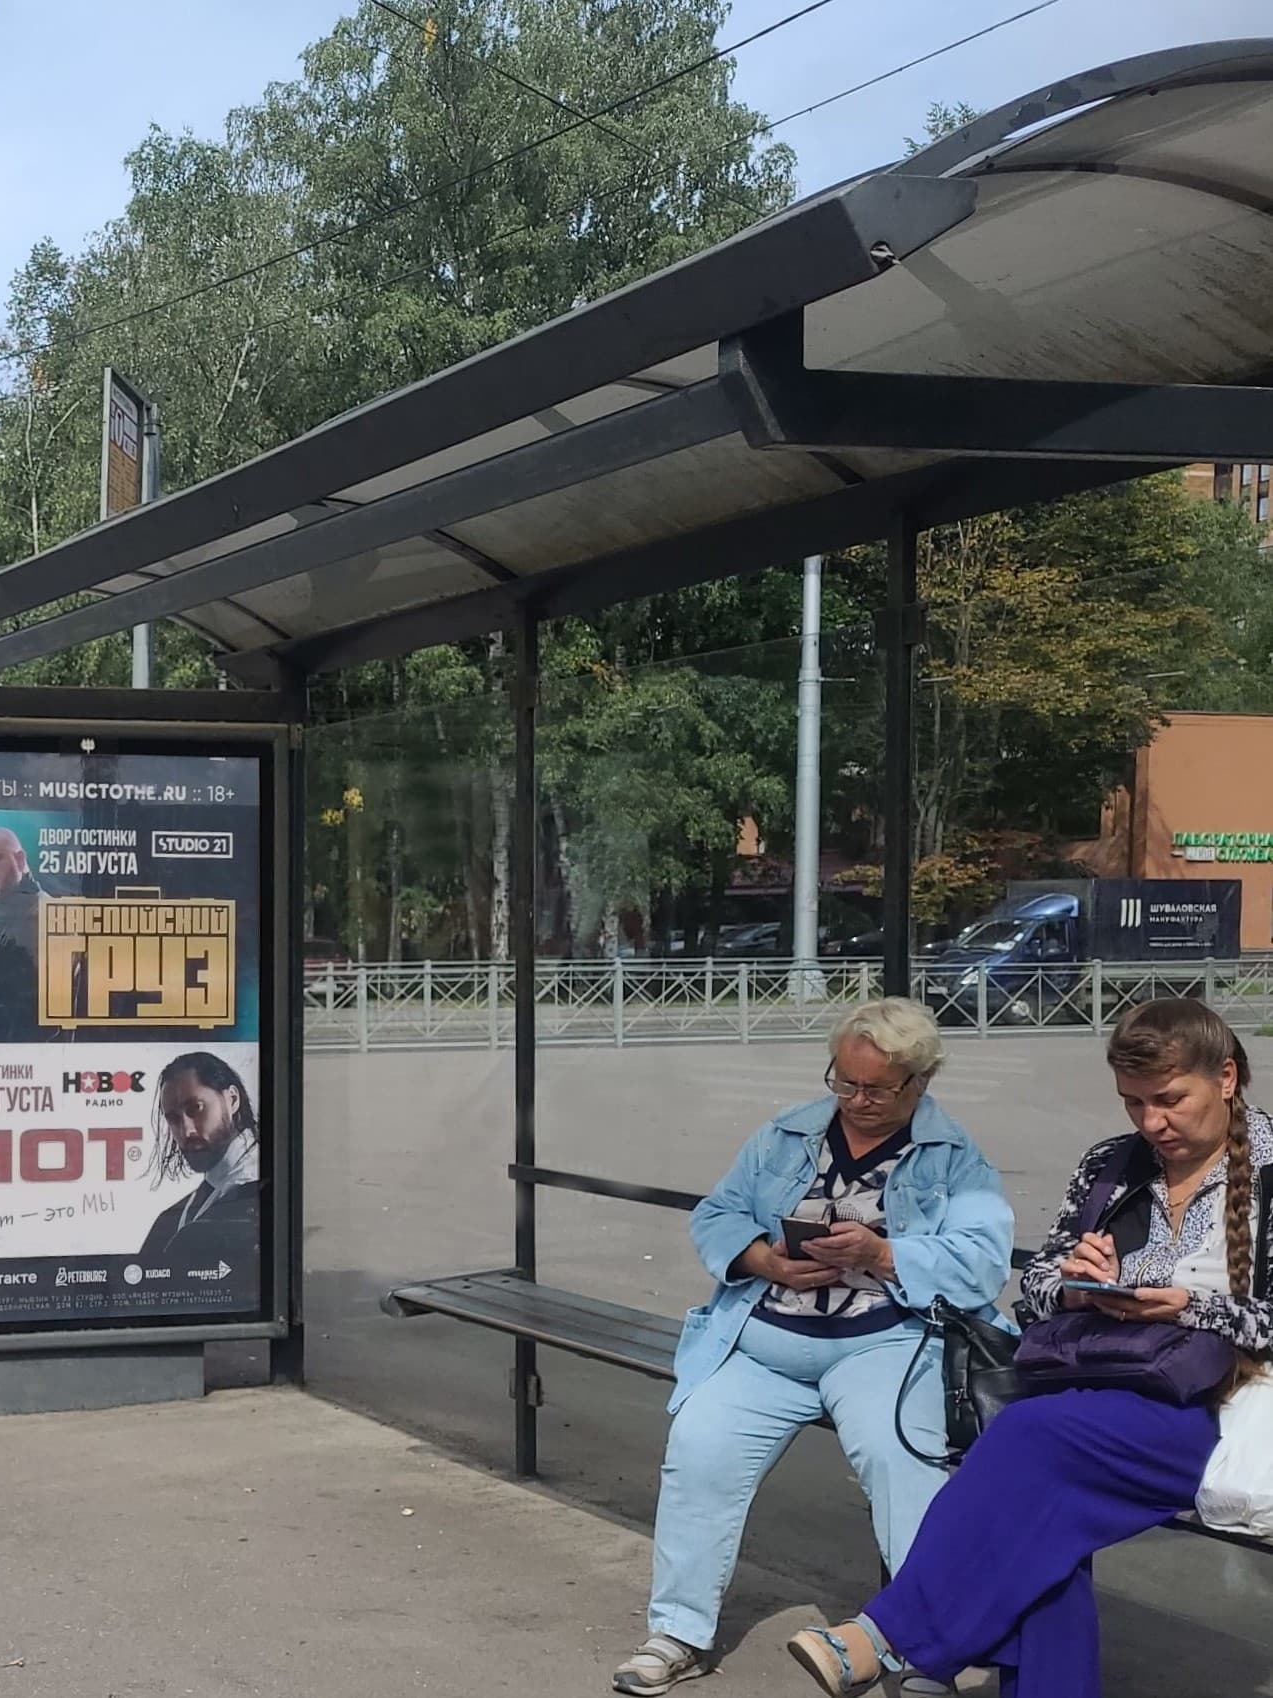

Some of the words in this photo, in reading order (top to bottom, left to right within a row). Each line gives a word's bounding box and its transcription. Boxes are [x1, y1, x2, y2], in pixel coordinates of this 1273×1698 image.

[39, 781, 187, 800] MUSICTOTHE.RU
[207, 785, 235, 802] 18+
[38, 828, 71, 847] ДВОР
[74, 828, 137, 847] ГОСТИНКИ
[158, 838, 209, 853] STUDIO
[212, 838, 227, 853] 21
[38, 851, 59, 874] 25
[63, 851, 138, 876] АВГУСТА
[1150, 903, 1217, 913] ШУВАЛОВСКАЯ
[47, 935, 229, 1017] ГРУЗ
[85, 1098, 124, 1108] РАДИО
[42, 1205, 75, 1222] это
